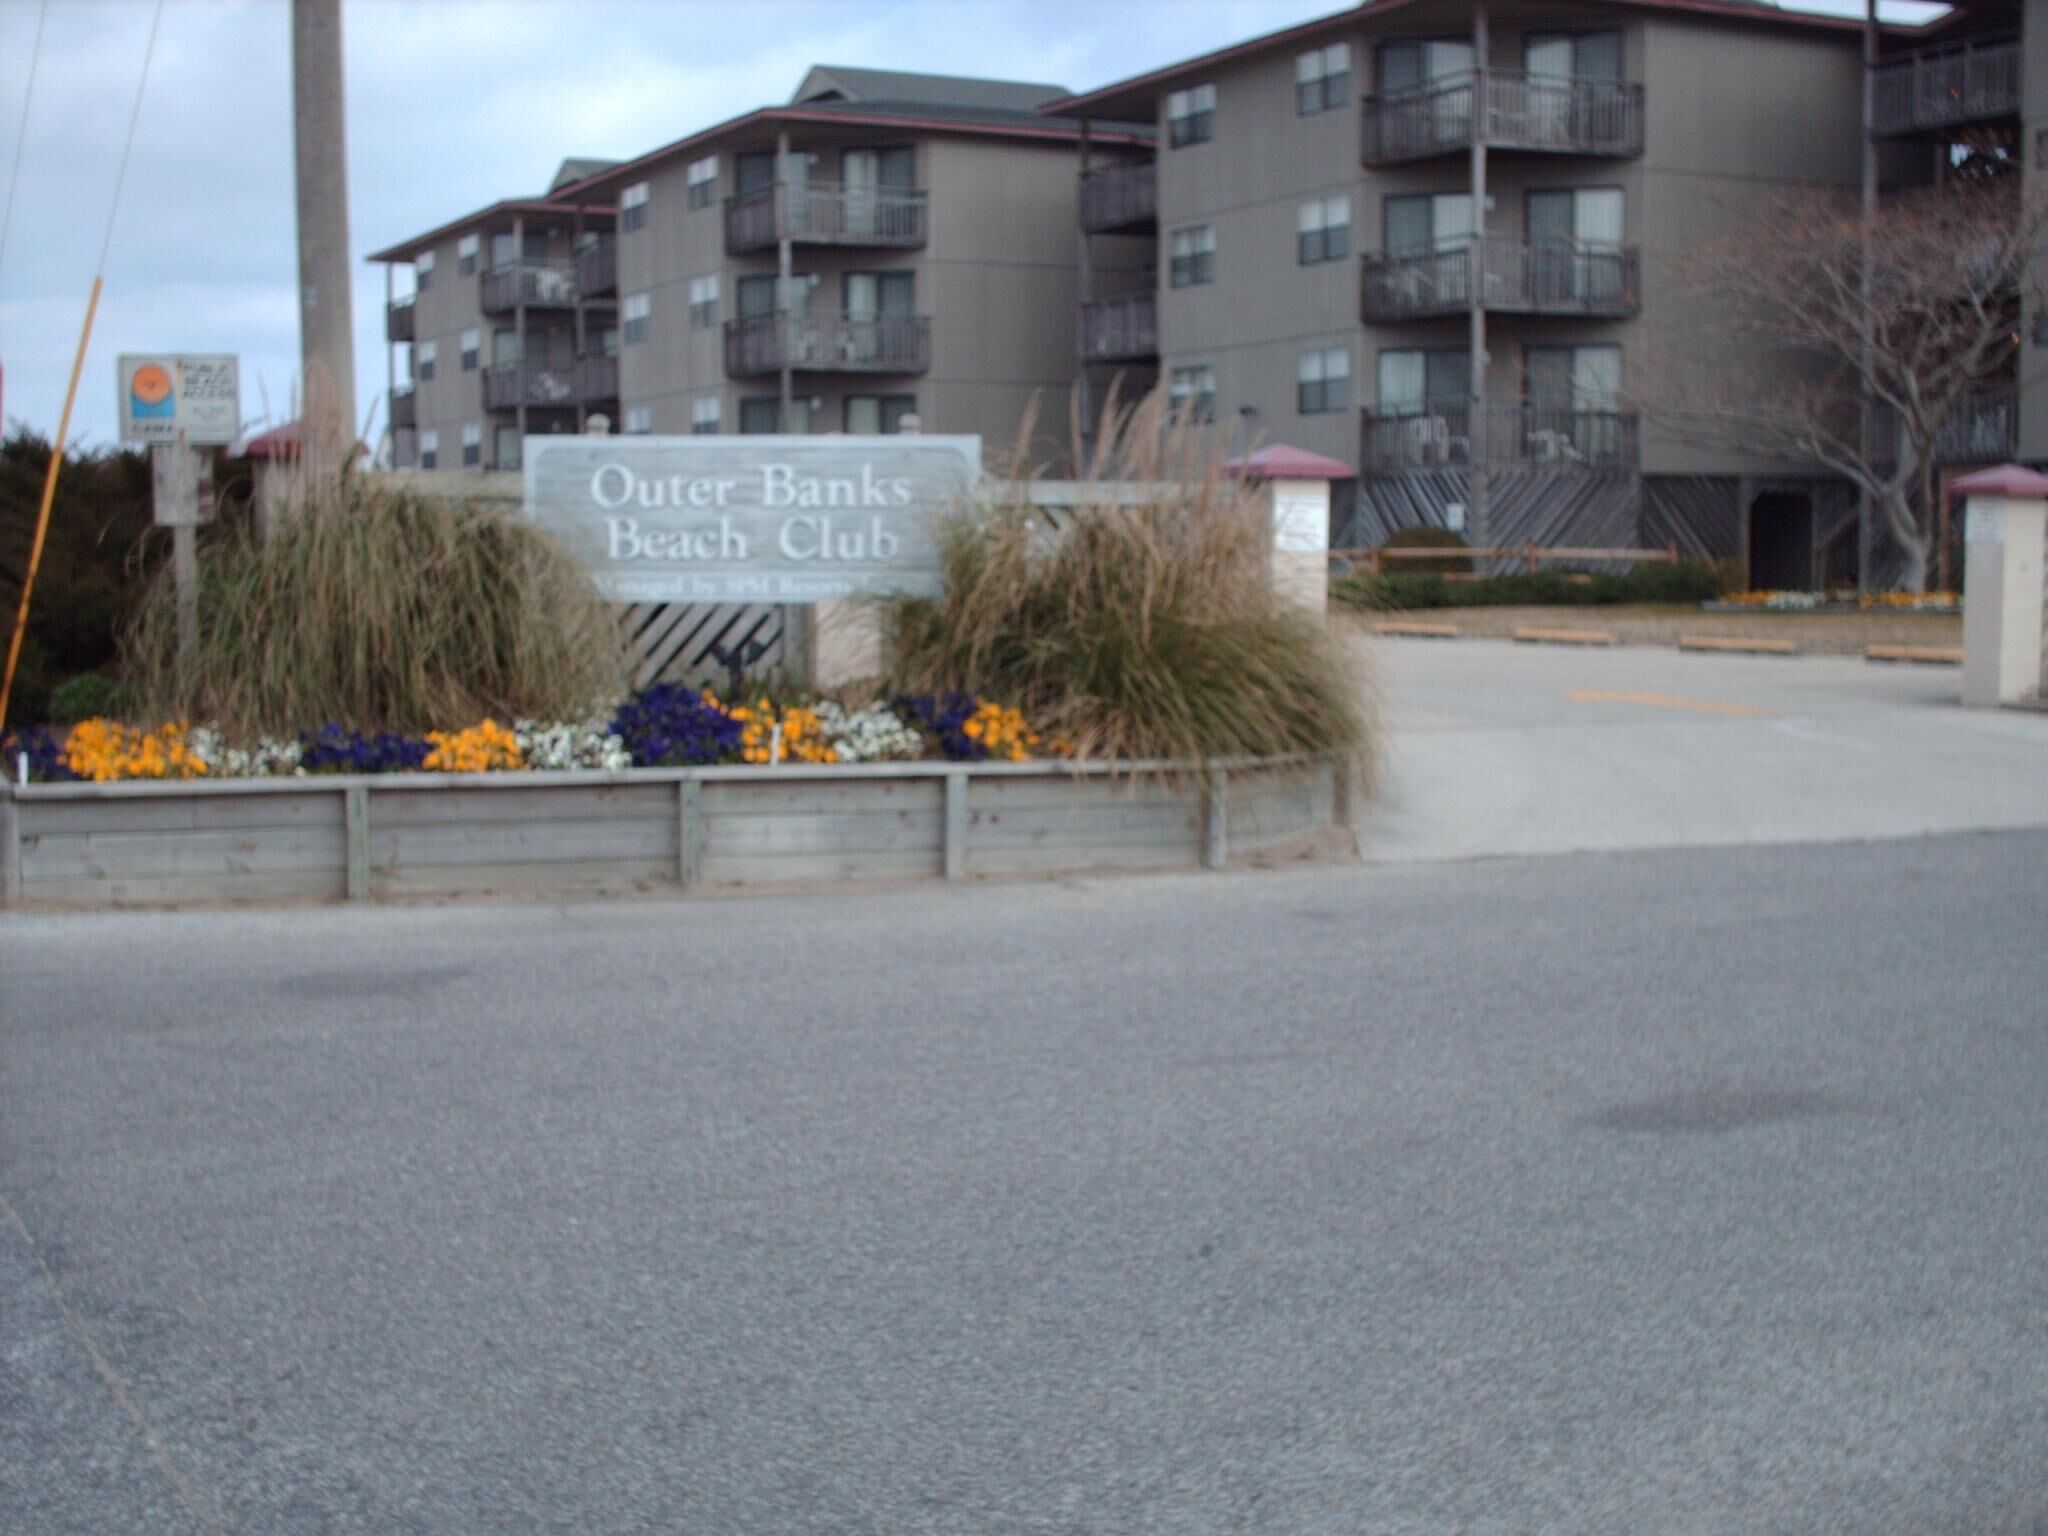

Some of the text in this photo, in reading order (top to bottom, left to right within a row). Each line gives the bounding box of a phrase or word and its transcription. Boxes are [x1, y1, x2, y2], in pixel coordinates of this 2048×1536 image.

[590, 463, 912, 508] Outer Banks
[605, 515, 900, 561] Beach Club
